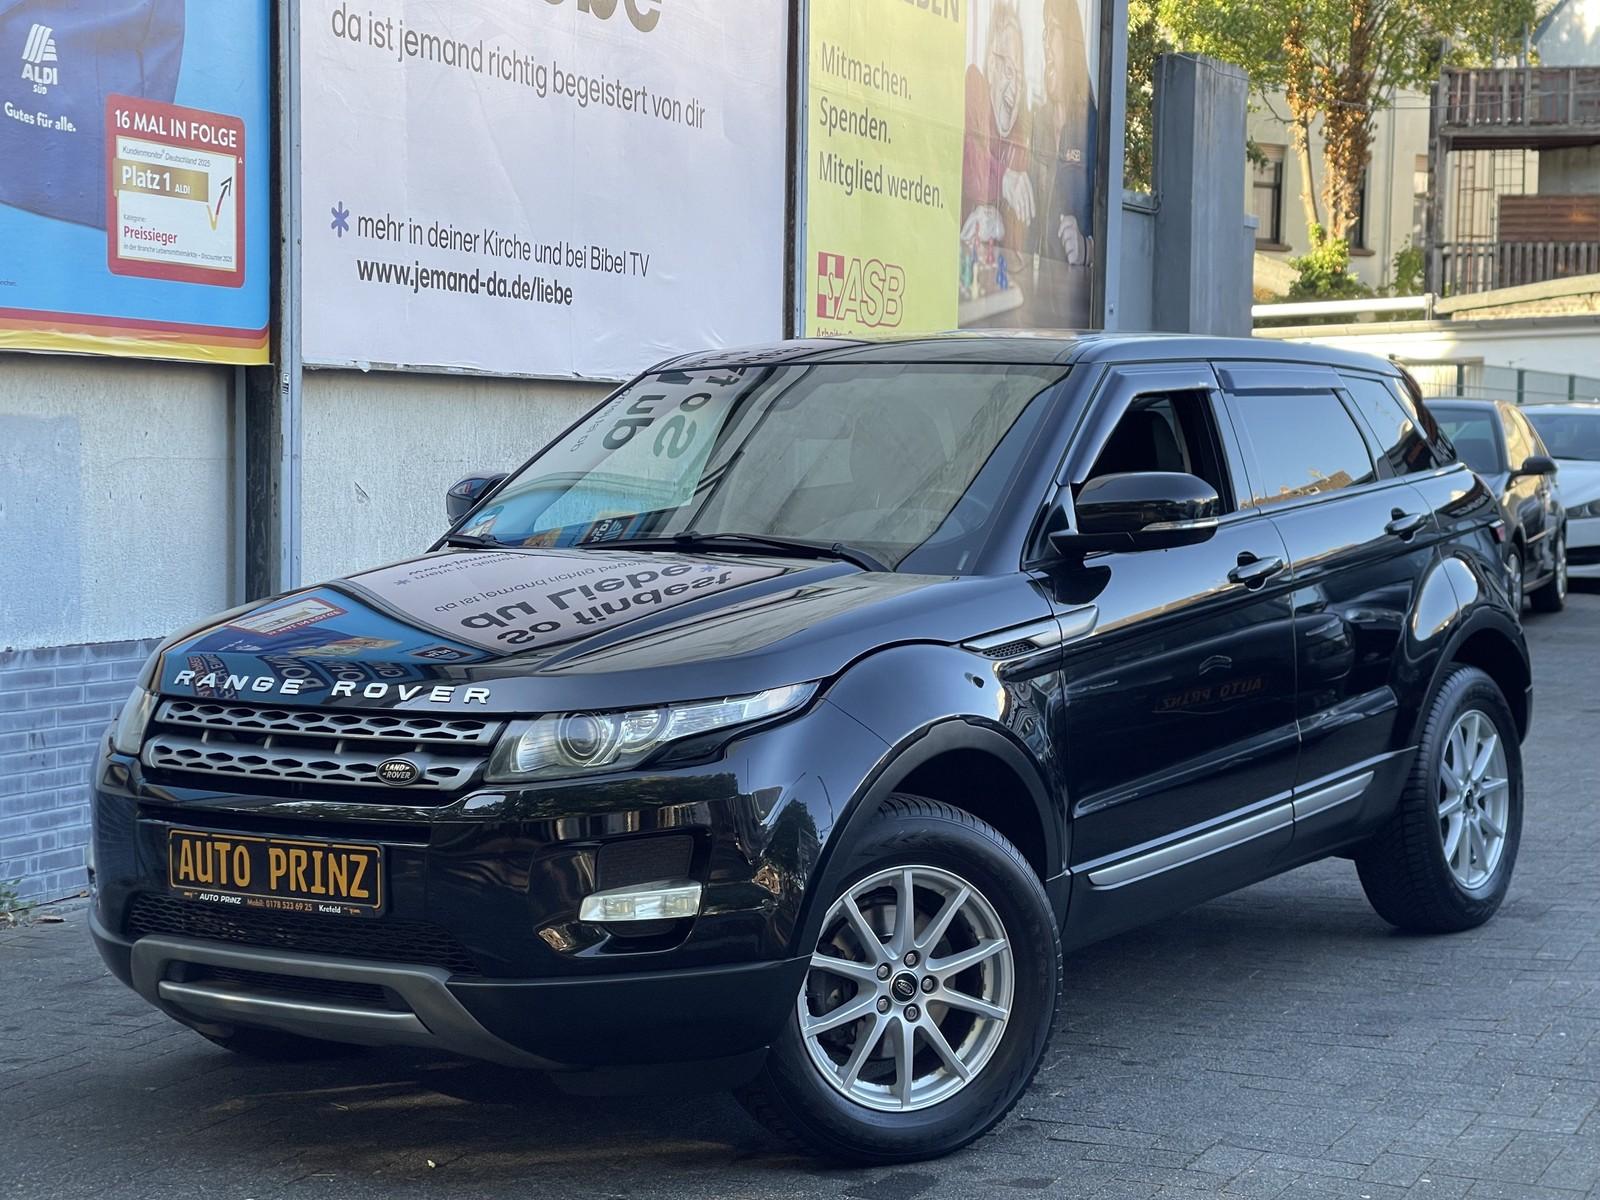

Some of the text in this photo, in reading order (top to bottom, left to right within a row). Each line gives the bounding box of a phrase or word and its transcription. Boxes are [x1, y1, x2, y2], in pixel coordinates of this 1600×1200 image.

[21, 63, 58, 86] ALDI
[332, 2, 705, 129] da ist jemand richtig begeistert von dir
[822, 41, 912, 100] Mitmachen.
[33, 84, 47, 95] SÜD
[4, 101, 76, 132] Gutes für alle.
[115, 109, 237, 148] 16 MAL IN FOLGE
[820, 96, 891, 144] Spenden.
[122, 165, 191, 194] Platz 1 ALDI
[819, 151, 944, 209] Mitglied werden.
[124, 225, 178, 246] Preissieger
[358, 213, 650, 277] mehr in deiner Kirche und bei Bibel TV
[357, 260, 573, 306] www.jemand-da.de/liebe
[836, 258, 905, 328] ASB
[173, 670, 304, 695] RANGE
[331, 681, 491, 704] ROVER
[385, 763, 406, 771] LAND
[386, 771, 411, 779] ROVER
[179, 839, 369, 898] AUTO PRINZ
[200, 893, 219, 902] AUTO
[266, 900, 280, 908] 0178
[295, 902, 303, 910] 69
[305, 903, 312, 911] 25
[319, 904, 341, 913] Krefeld
